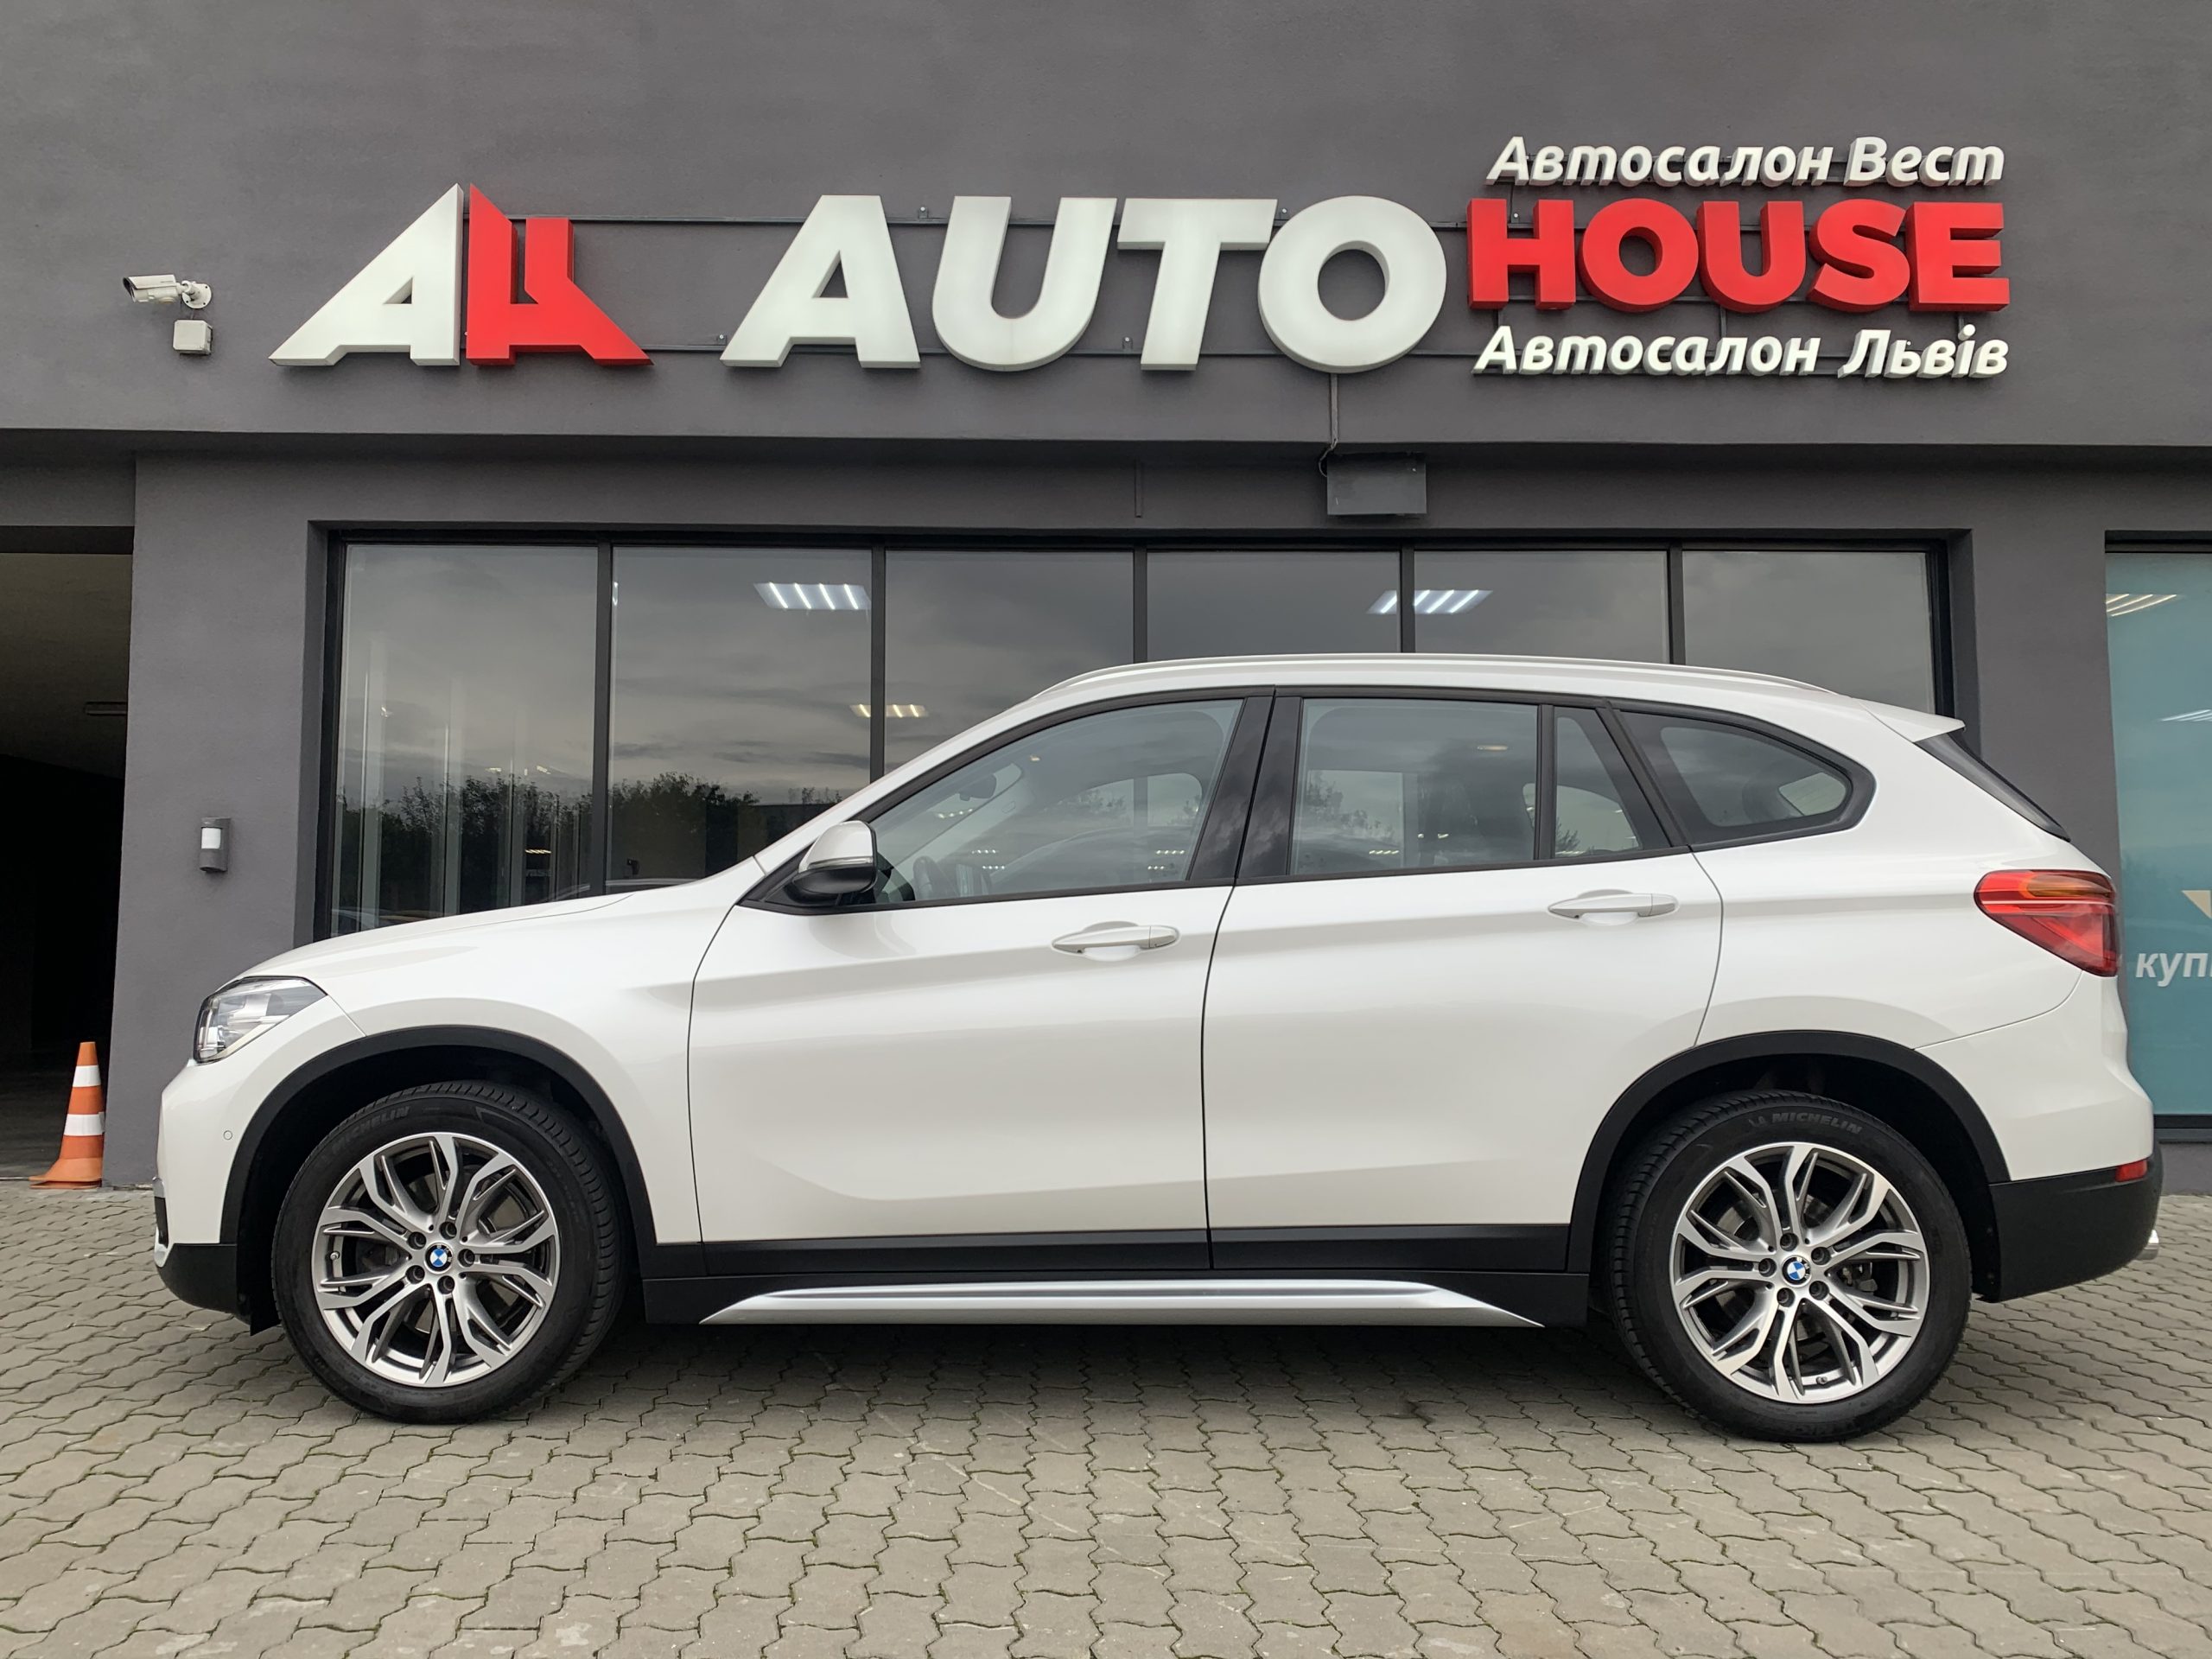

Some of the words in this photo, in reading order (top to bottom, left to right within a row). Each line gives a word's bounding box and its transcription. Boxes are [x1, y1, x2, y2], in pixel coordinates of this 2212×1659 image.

[1486, 136, 1834, 187] Автосалон
[1844, 136, 2005, 187] Вест
[721, 195, 1447, 373] AUTO
[1467, 198, 2010, 312] HOUSE
[1471, 325, 1821, 377] Автосалон
[1838, 324, 2010, 378] Львів
[2135, 952, 2212, 988] куп
[1772, 1112, 1863, 1135] MICHELIN
